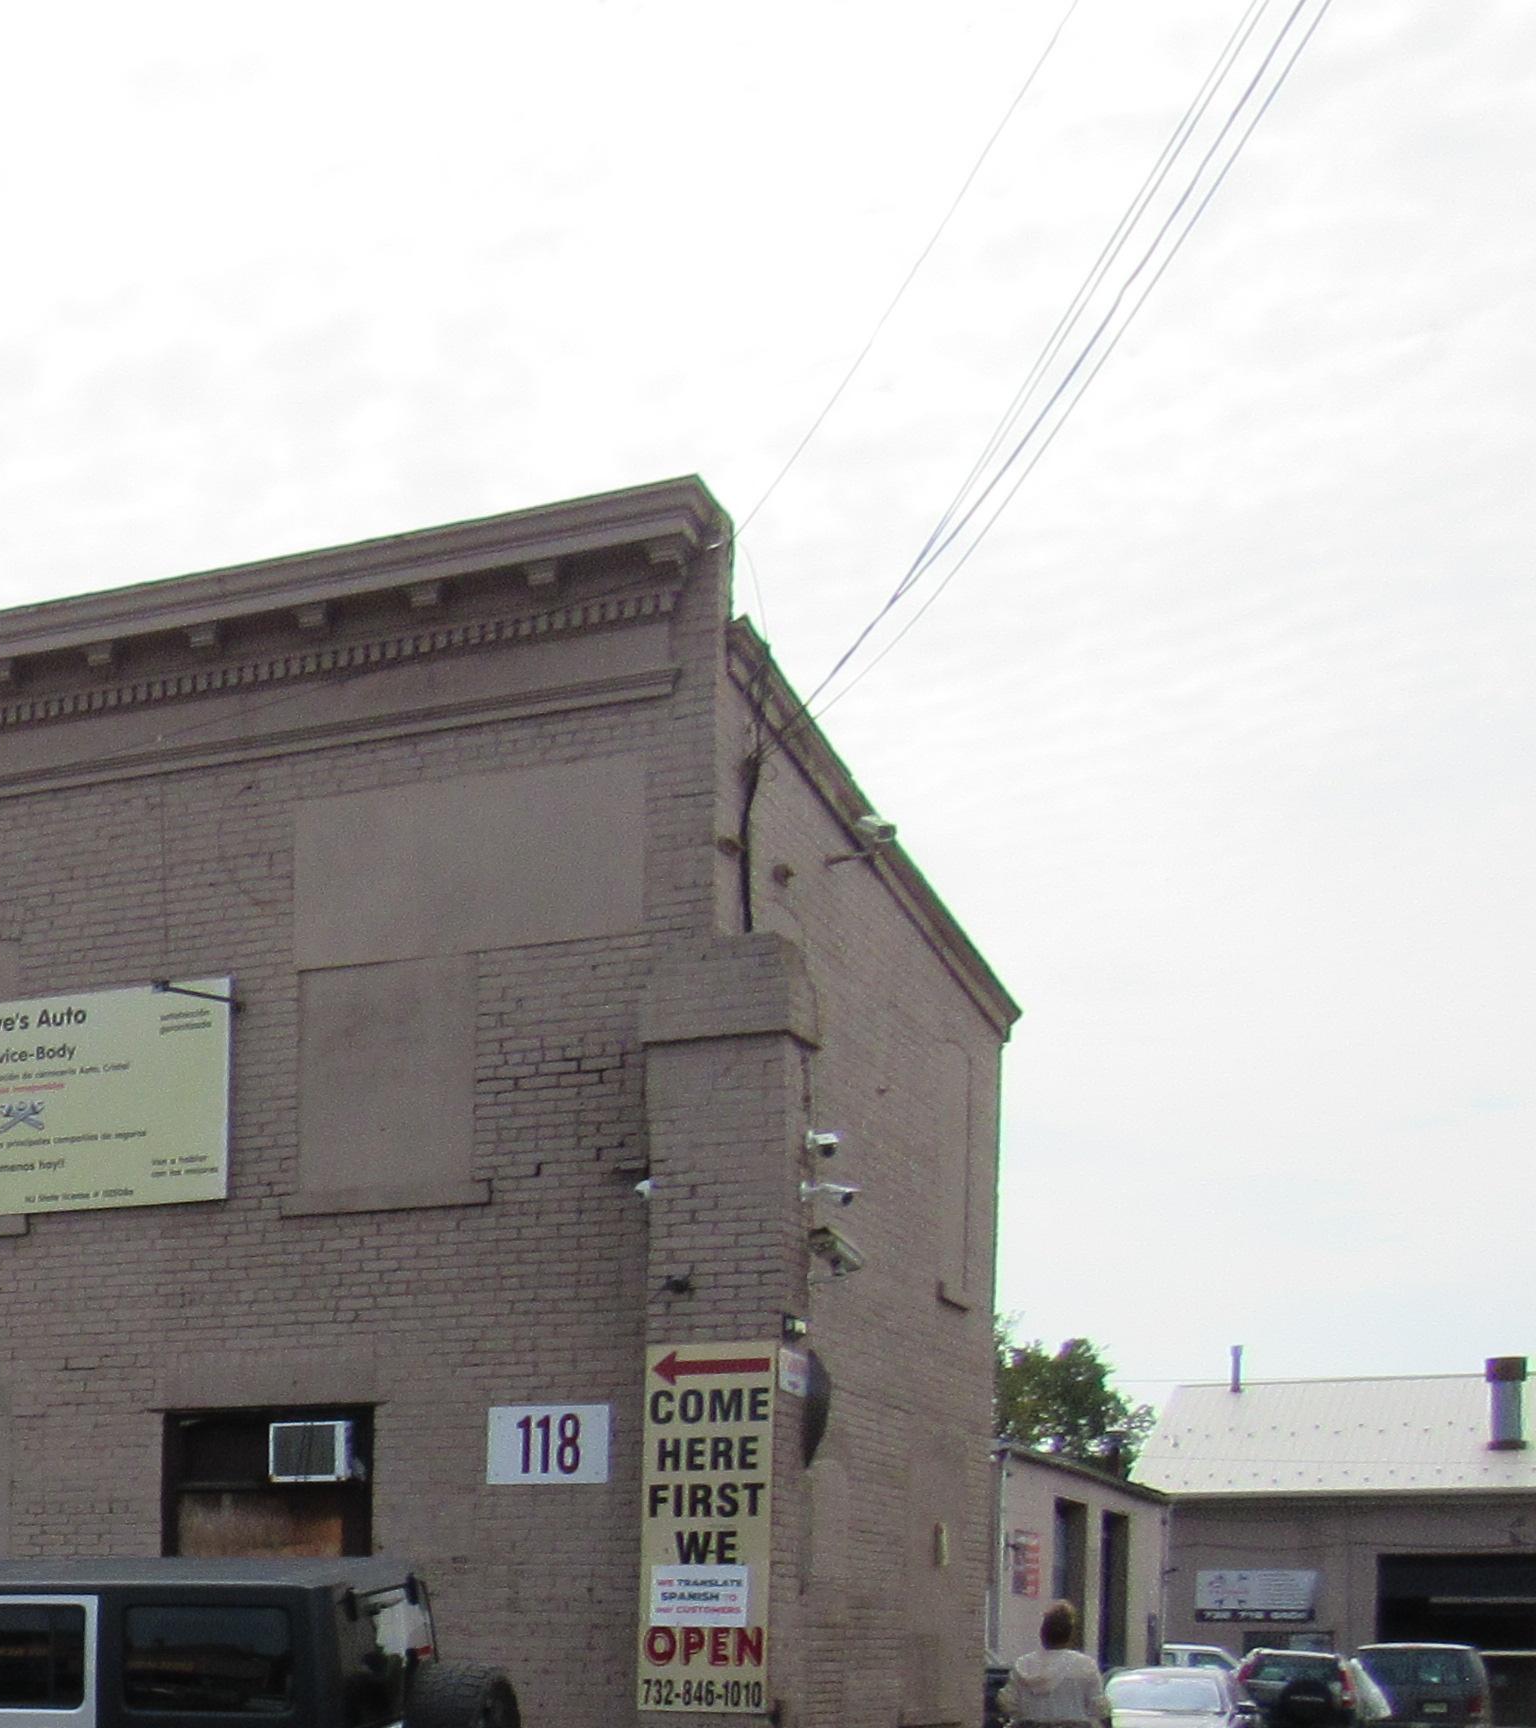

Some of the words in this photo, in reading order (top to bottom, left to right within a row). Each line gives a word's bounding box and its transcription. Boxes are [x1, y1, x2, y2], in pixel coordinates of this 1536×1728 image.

[36, 1006, 87, 1028] Auto
[650, 1387, 770, 1424] COME
[516, 1412, 581, 1475] 118
[657, 1435, 759, 1472] HERE
[648, 1482, 765, 1518] FIRST
[675, 1530, 737, 1565] WE
[660, 1592, 720, 1602] SPANISH
[677, 1578, 742, 1587] TRANSLATE
[643, 1626, 764, 1668] OPEN
[642, 1678, 764, 1708] 732-846-1010
